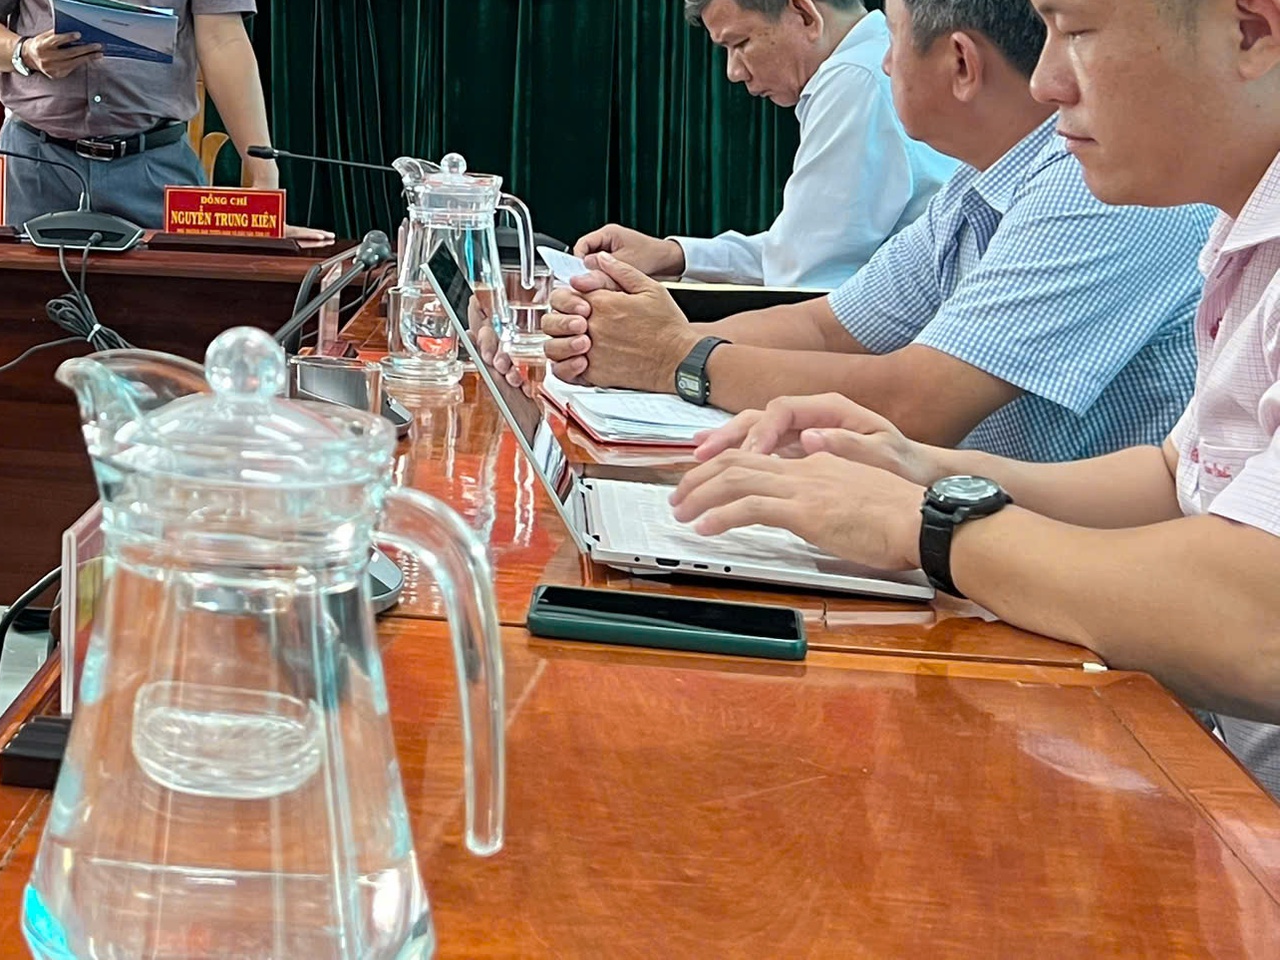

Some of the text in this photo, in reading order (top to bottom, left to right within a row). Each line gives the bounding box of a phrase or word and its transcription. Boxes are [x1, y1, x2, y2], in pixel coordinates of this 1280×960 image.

[230, 196, 248, 206] CHÍ
[214, 212, 248, 227] TRUNG
[251, 211, 277, 229] KIÊN
